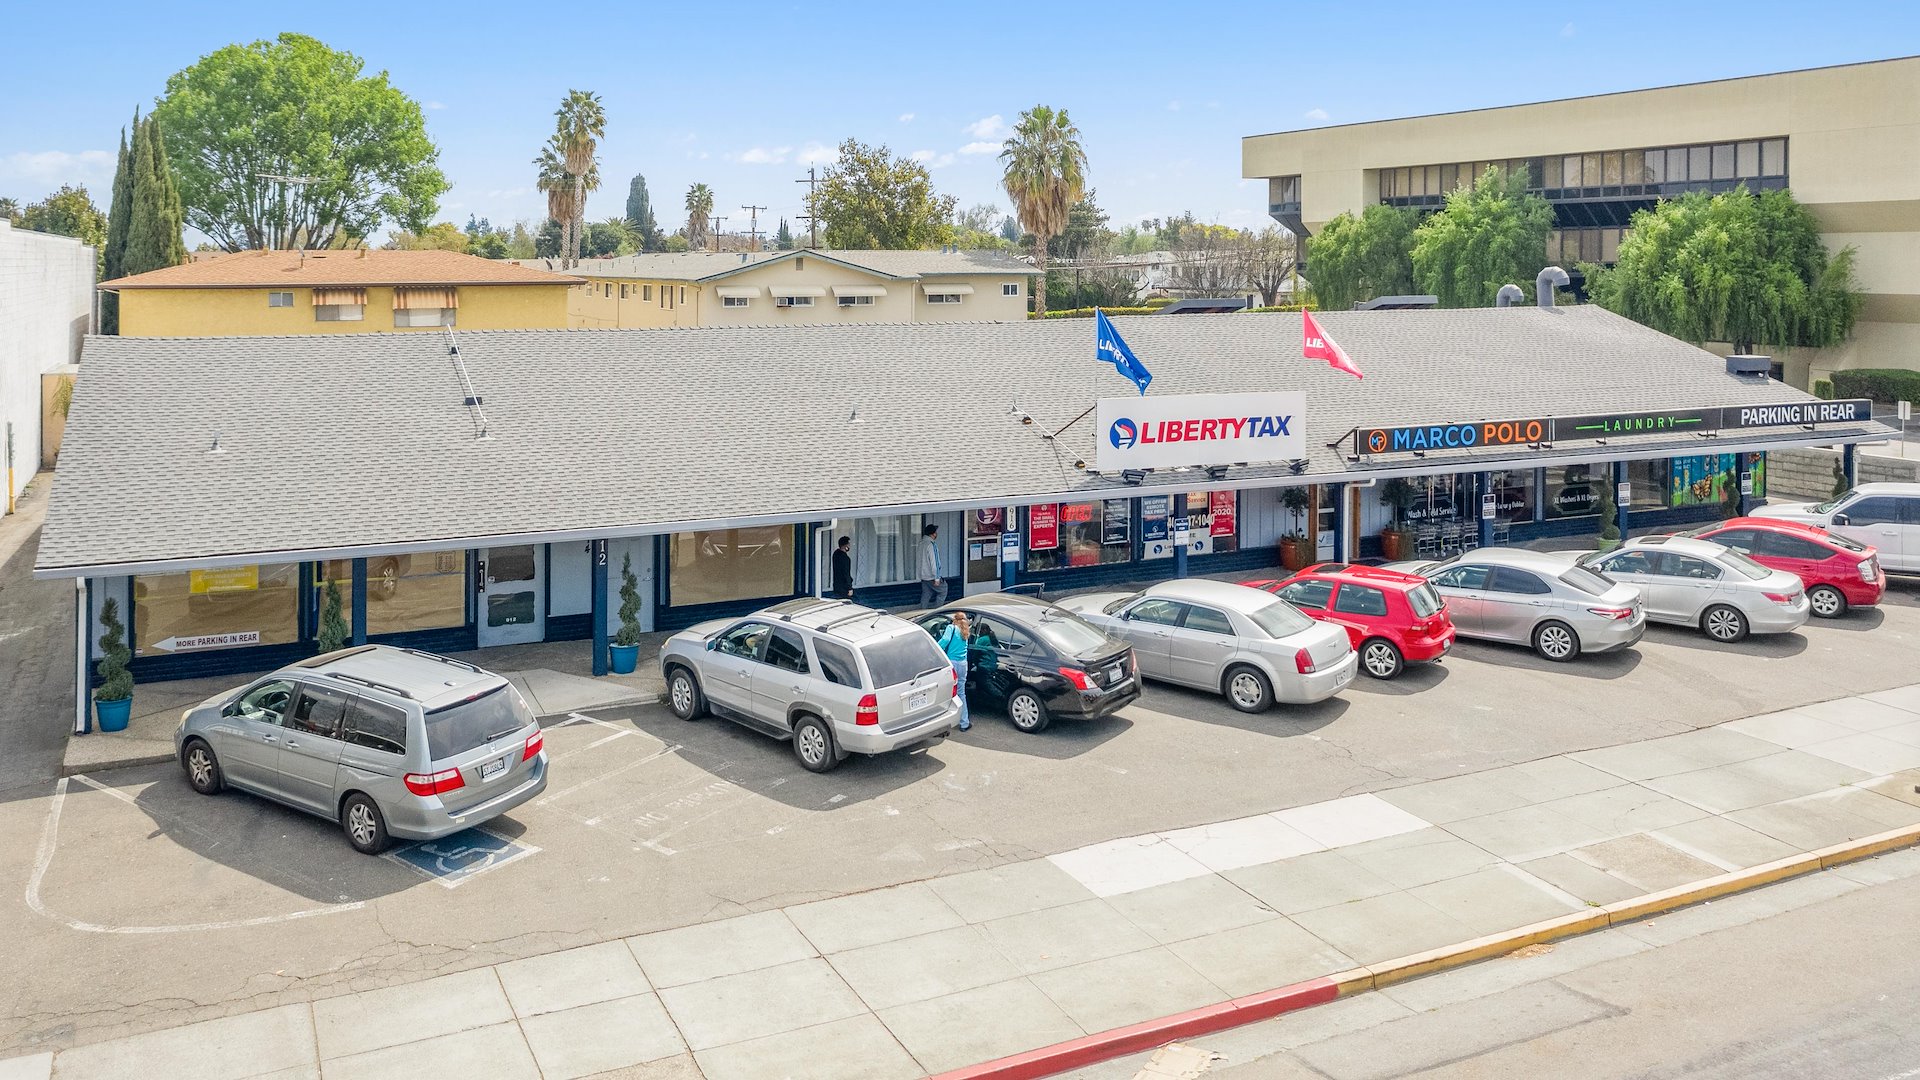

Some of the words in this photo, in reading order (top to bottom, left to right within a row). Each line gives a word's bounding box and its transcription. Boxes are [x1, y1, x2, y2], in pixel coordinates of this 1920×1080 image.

[1741, 406, 1800, 425] PARKING
[1803, 405, 1817, 422] IN
[1820, 403, 1855, 420] REAR
[1604, 416, 1675, 432] LAUNDRY
[1393, 425, 1476, 450] MARCO
[1483, 421, 1542, 444] POLO
[1060, 504, 1093, 522] OPEN
[1407, 509, 1421, 518] Wash
[176, 640, 196, 648] MORE
[197, 635, 228, 646] PARKING
[239, 633, 257, 642] REAR
